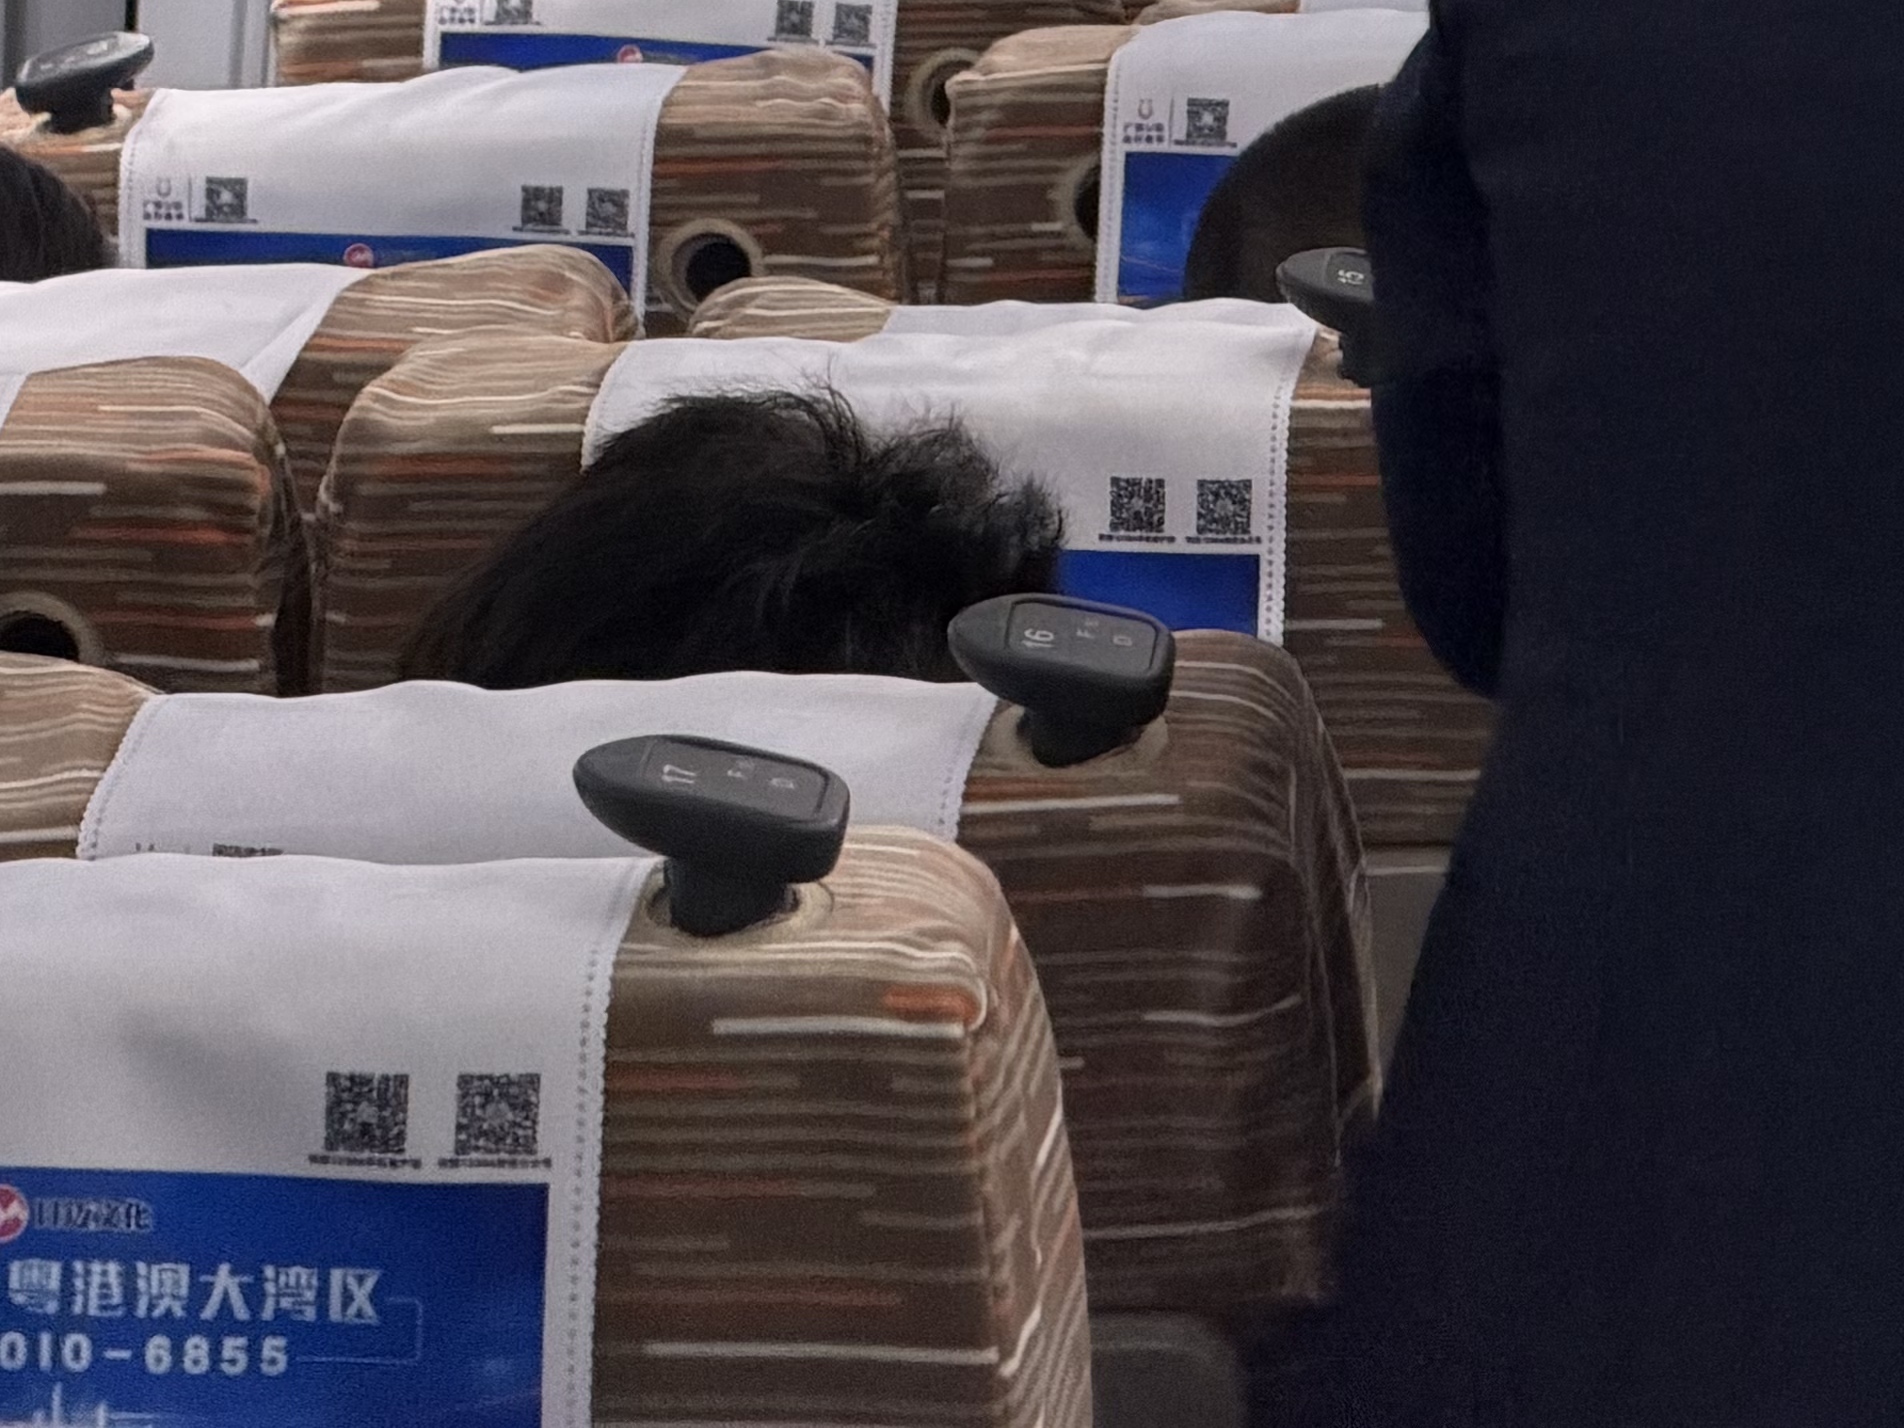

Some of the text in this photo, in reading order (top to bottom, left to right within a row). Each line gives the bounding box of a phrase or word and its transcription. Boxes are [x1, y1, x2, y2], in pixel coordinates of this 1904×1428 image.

[1021, 627, 1056, 649] 16
[661, 763, 697, 786] 17
[8, 1257, 383, 1326] 粤港澳大湾区
